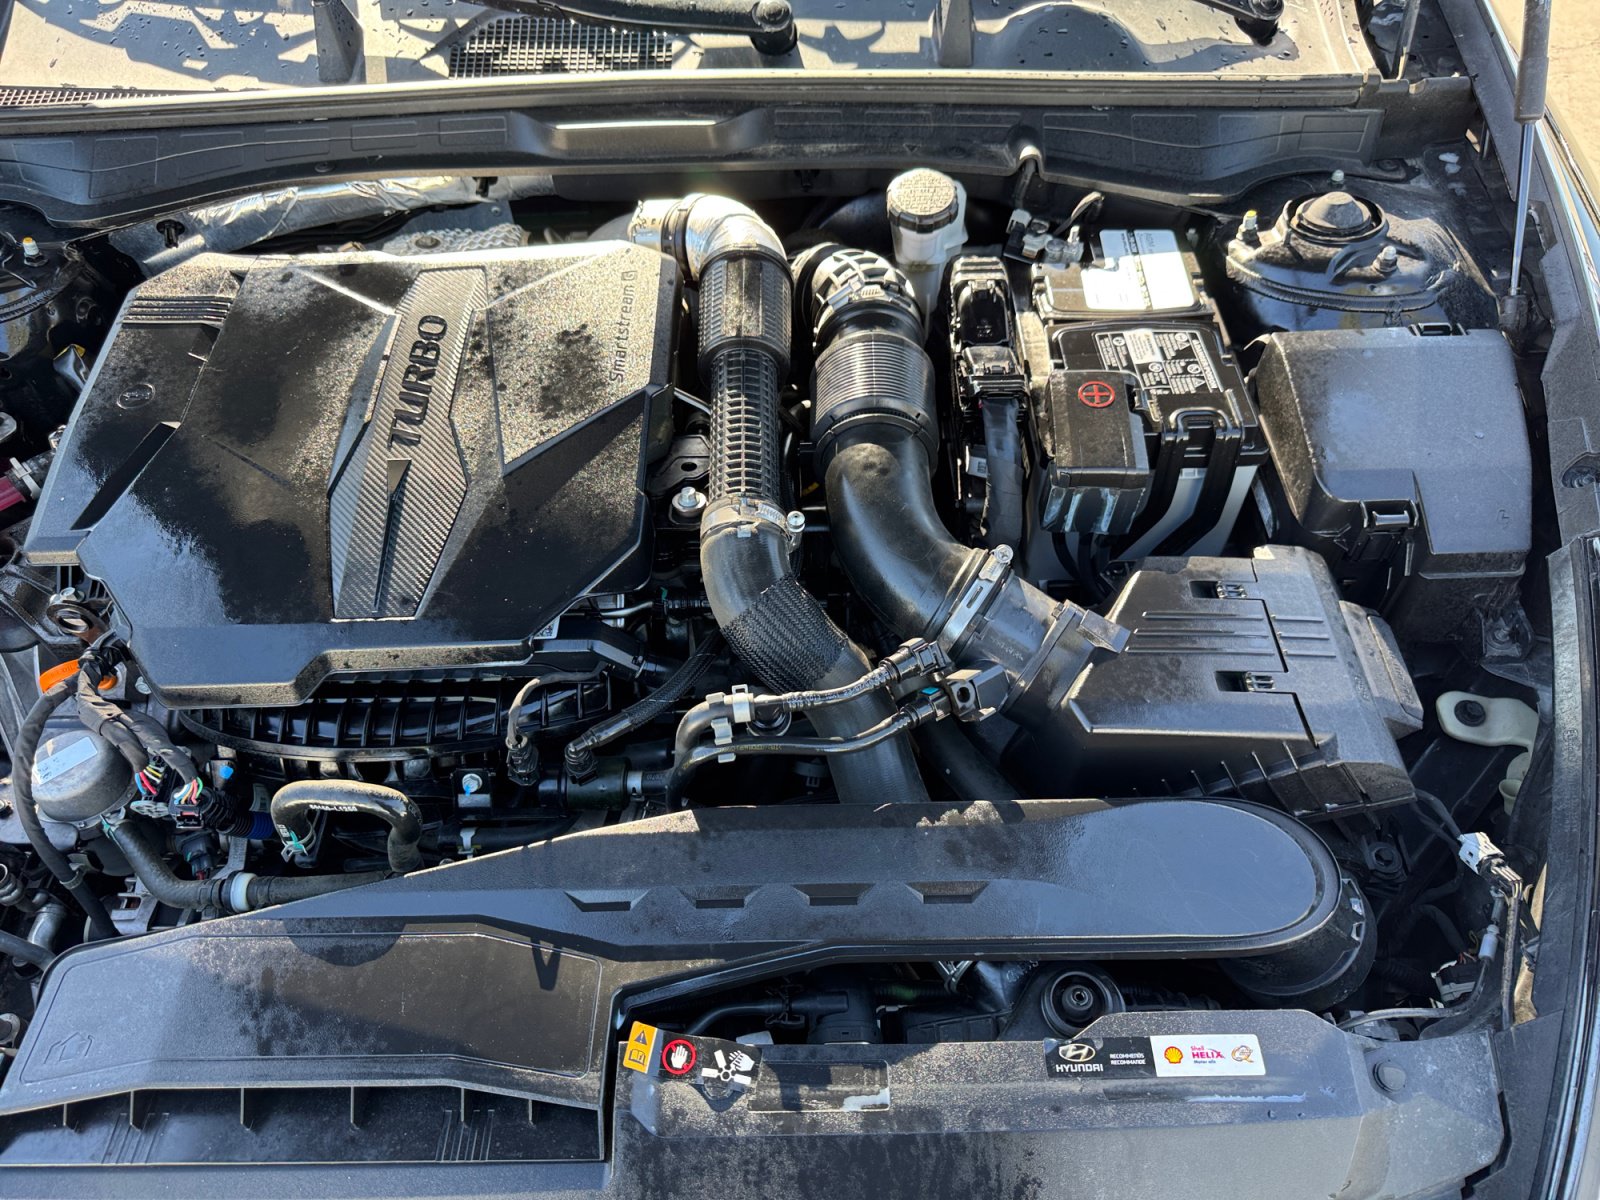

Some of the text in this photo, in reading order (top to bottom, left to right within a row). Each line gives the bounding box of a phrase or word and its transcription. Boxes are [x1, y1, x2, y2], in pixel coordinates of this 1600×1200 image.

[608, 285, 637, 384] Smartstream
[387, 315, 448, 447] TURBO
[1055, 1063, 1104, 1072] HYUNDAI
[1191, 1051, 1225, 1059] HELIX
